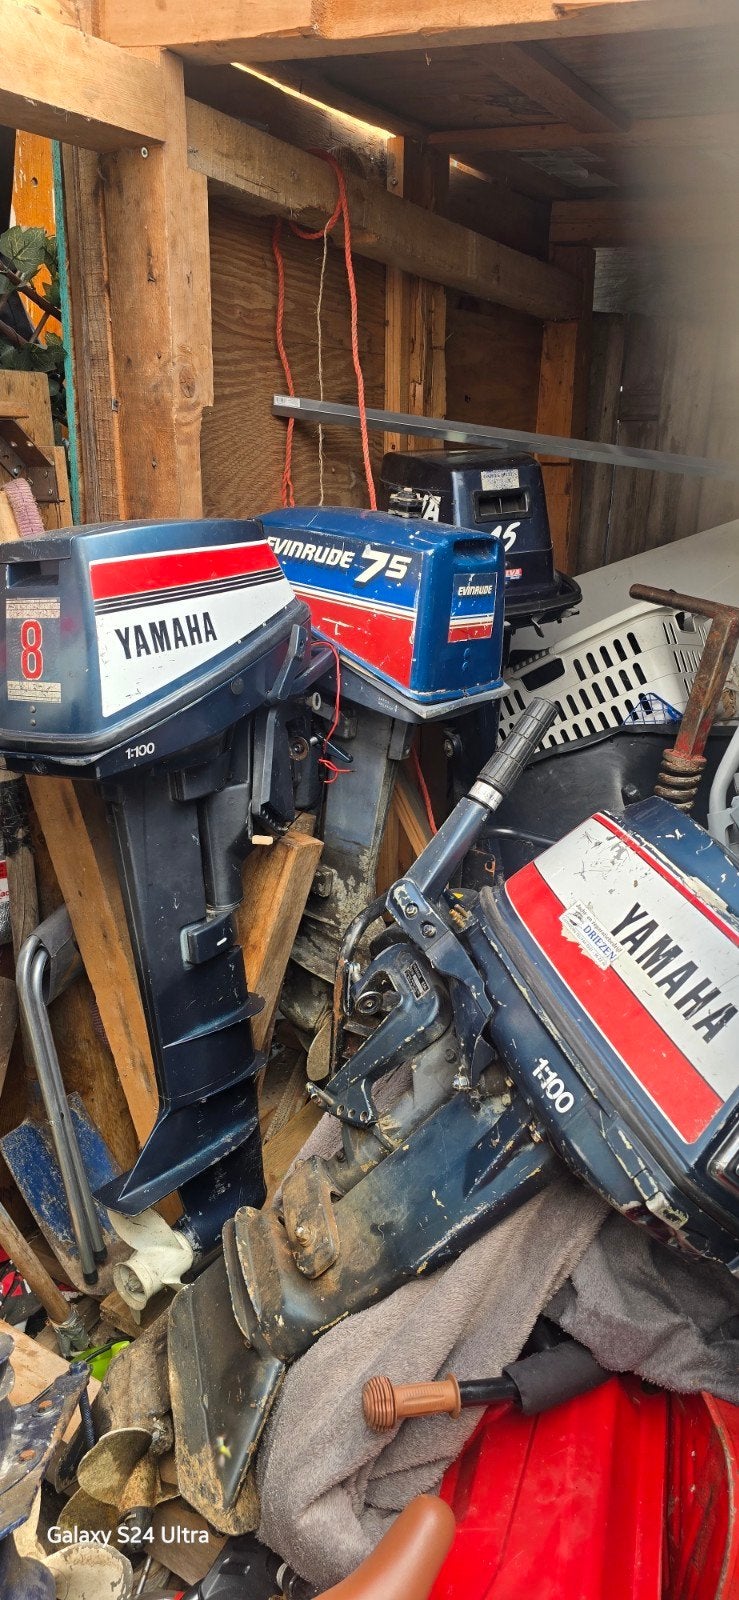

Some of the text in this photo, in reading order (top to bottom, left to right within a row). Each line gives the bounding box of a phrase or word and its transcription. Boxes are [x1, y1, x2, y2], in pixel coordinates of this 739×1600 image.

[266, 536, 356, 569] EVINRUDE
[457, 584, 493, 596] EVINRUDE
[20, 618, 44, 681] 8
[114, 611, 218, 659] YAMAHA
[125, 742, 155, 760] 1:100
[583, 925, 617, 962] DRIEZEN
[611, 901, 739, 1044] YAMAHA
[531, 1056, 575, 1114] 1:100
